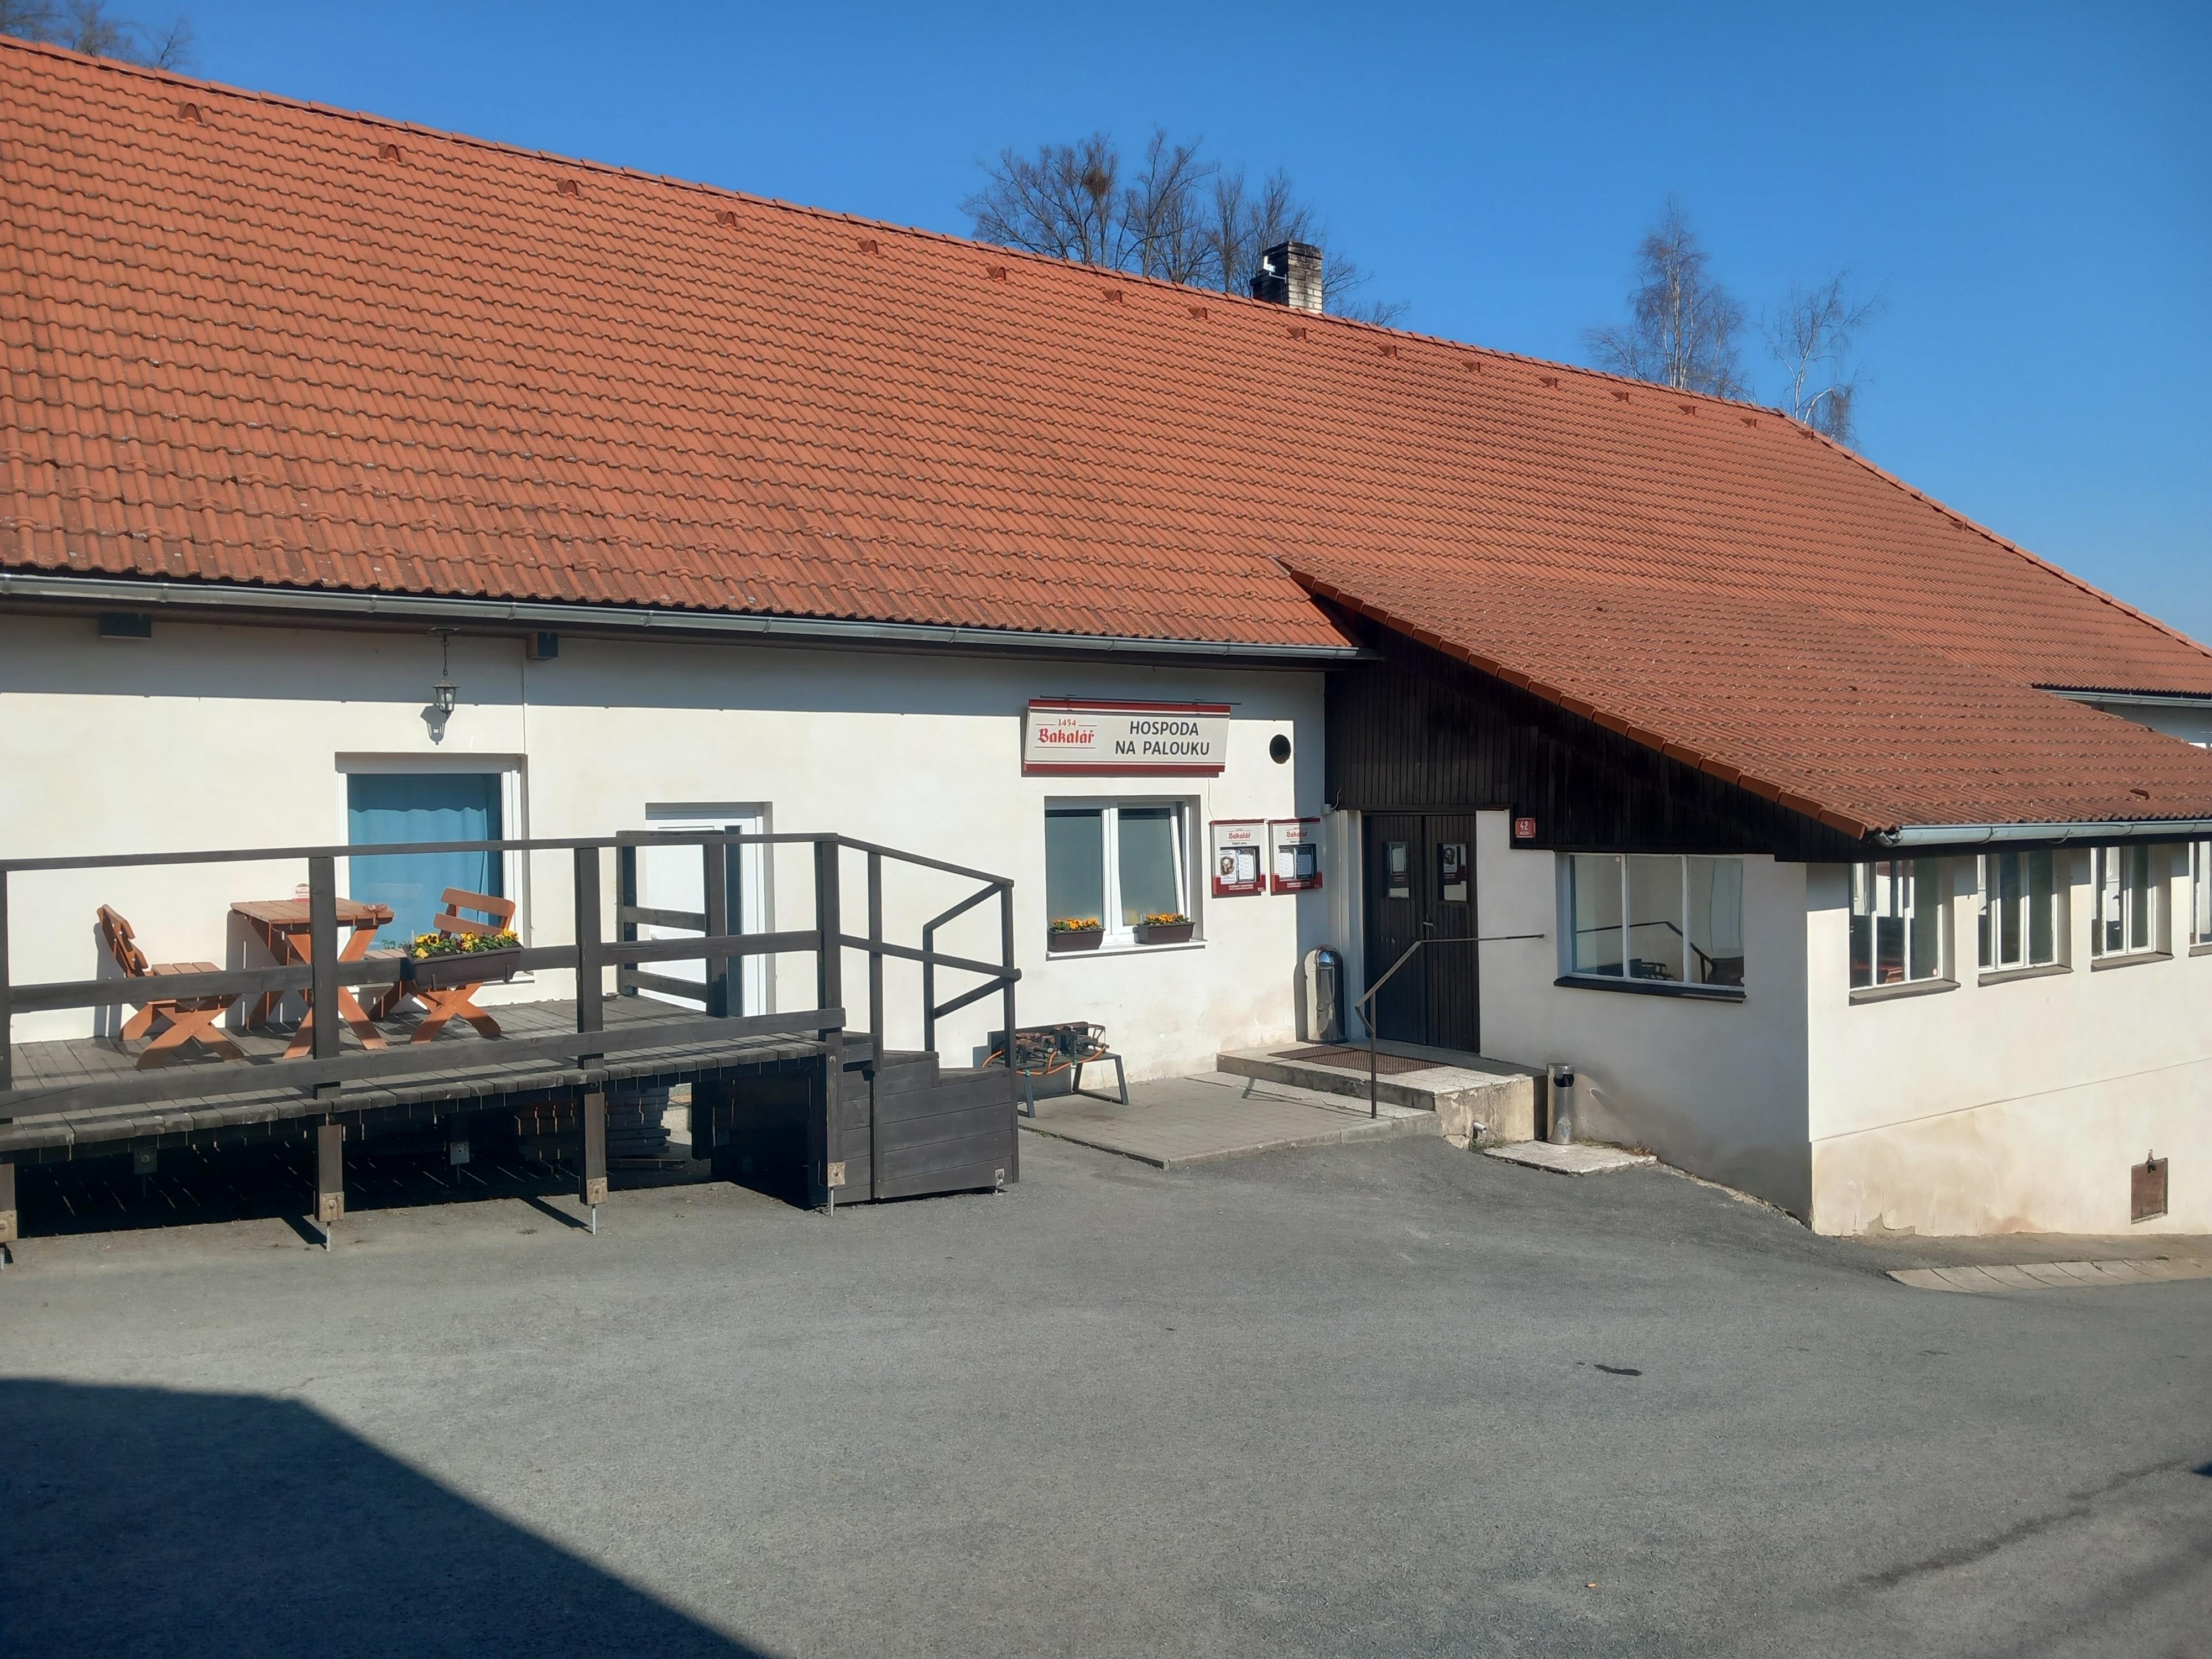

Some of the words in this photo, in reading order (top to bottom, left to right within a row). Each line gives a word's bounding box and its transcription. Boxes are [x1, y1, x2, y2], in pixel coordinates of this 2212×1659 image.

[1130, 721, 1199, 735] HOSPODA
[1037, 728, 1095, 743] Bakalář
[1115, 740, 1136, 754] NA
[1143, 741, 1210, 755] PALOUKU
[1520, 821, 1528, 830] 42
